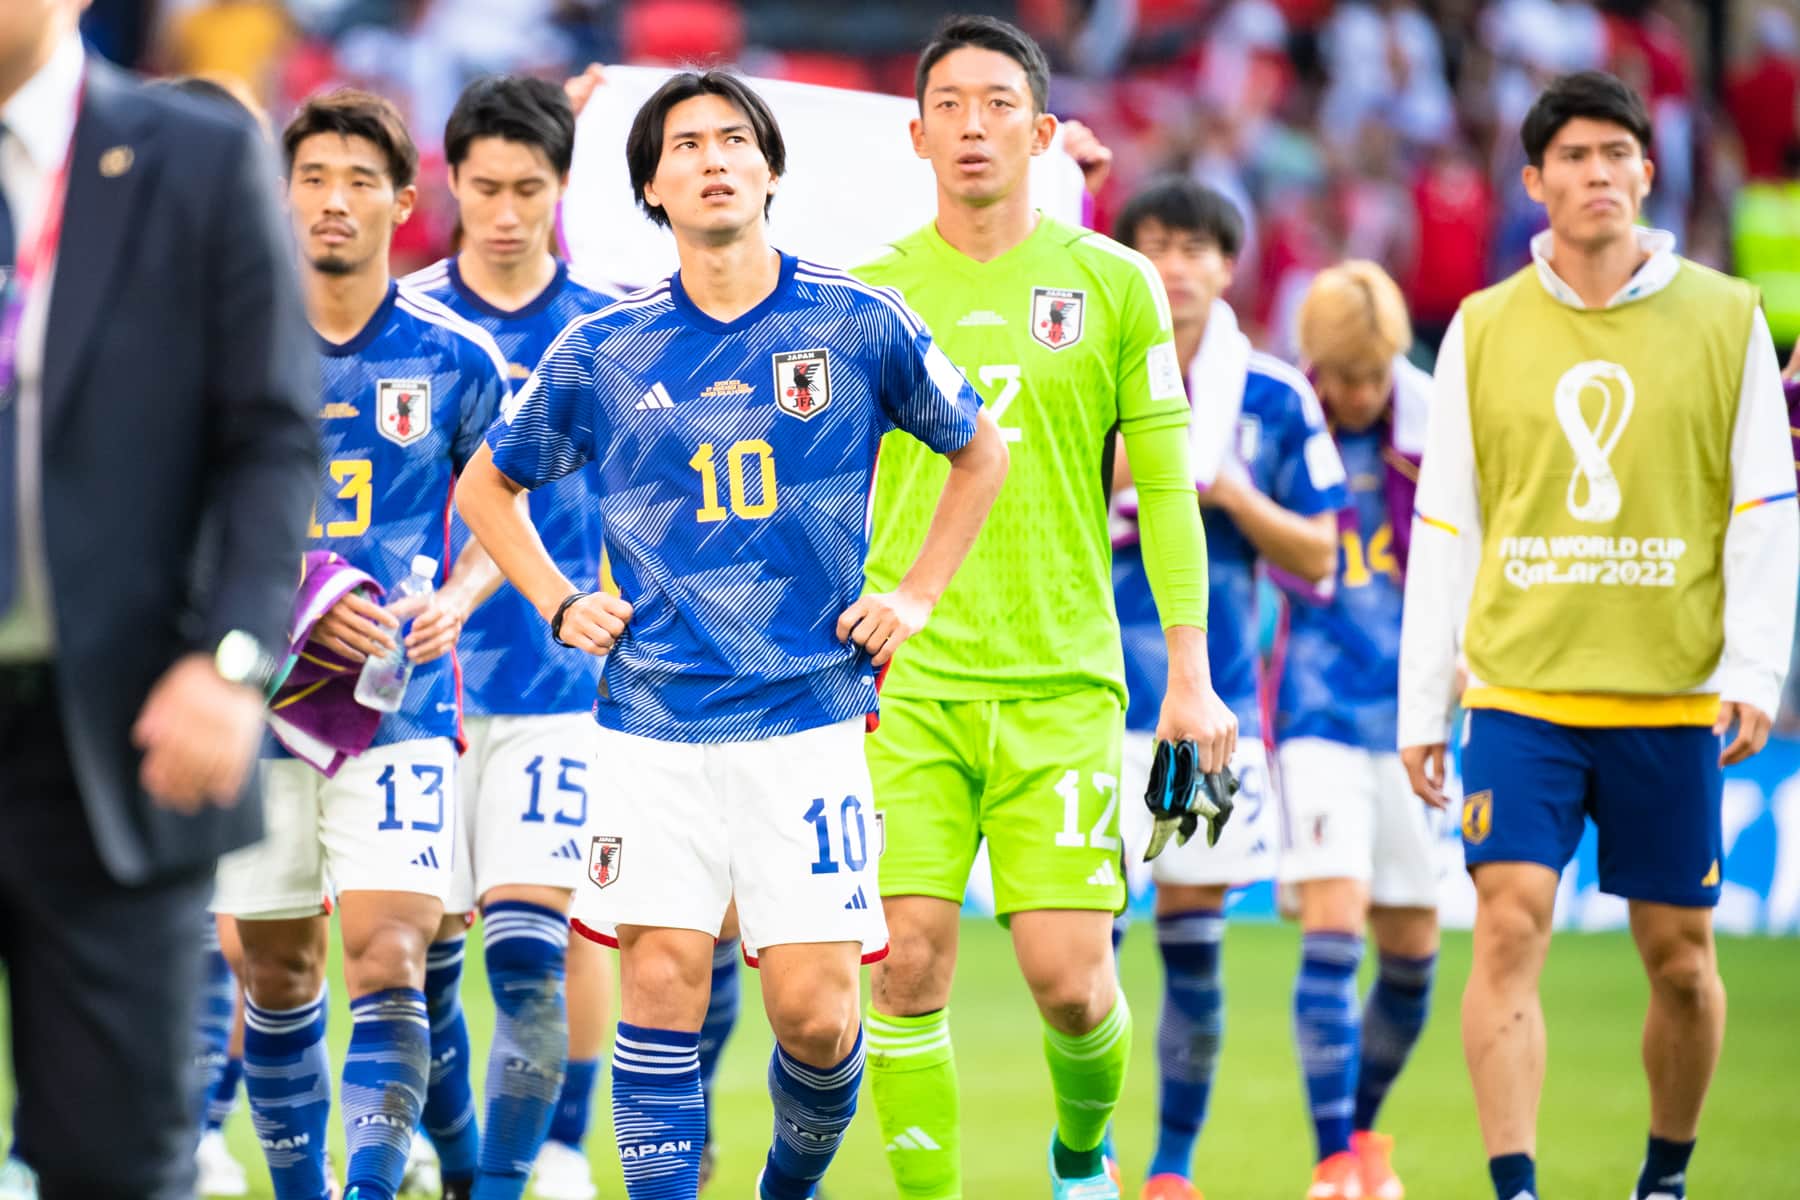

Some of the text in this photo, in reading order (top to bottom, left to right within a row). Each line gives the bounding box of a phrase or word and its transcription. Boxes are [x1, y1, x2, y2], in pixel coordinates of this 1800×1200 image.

[787, 352, 815, 361] JAPAN
[792, 396, 816, 408] JFA
[688, 438, 778, 523] 10
[1500, 536, 1686, 559] FIFA WORLD CUP
[376, 764, 444, 832] 13
[521, 755, 587, 827] 15
[1053, 769, 1119, 850] 12
[803, 795, 867, 874] 10
